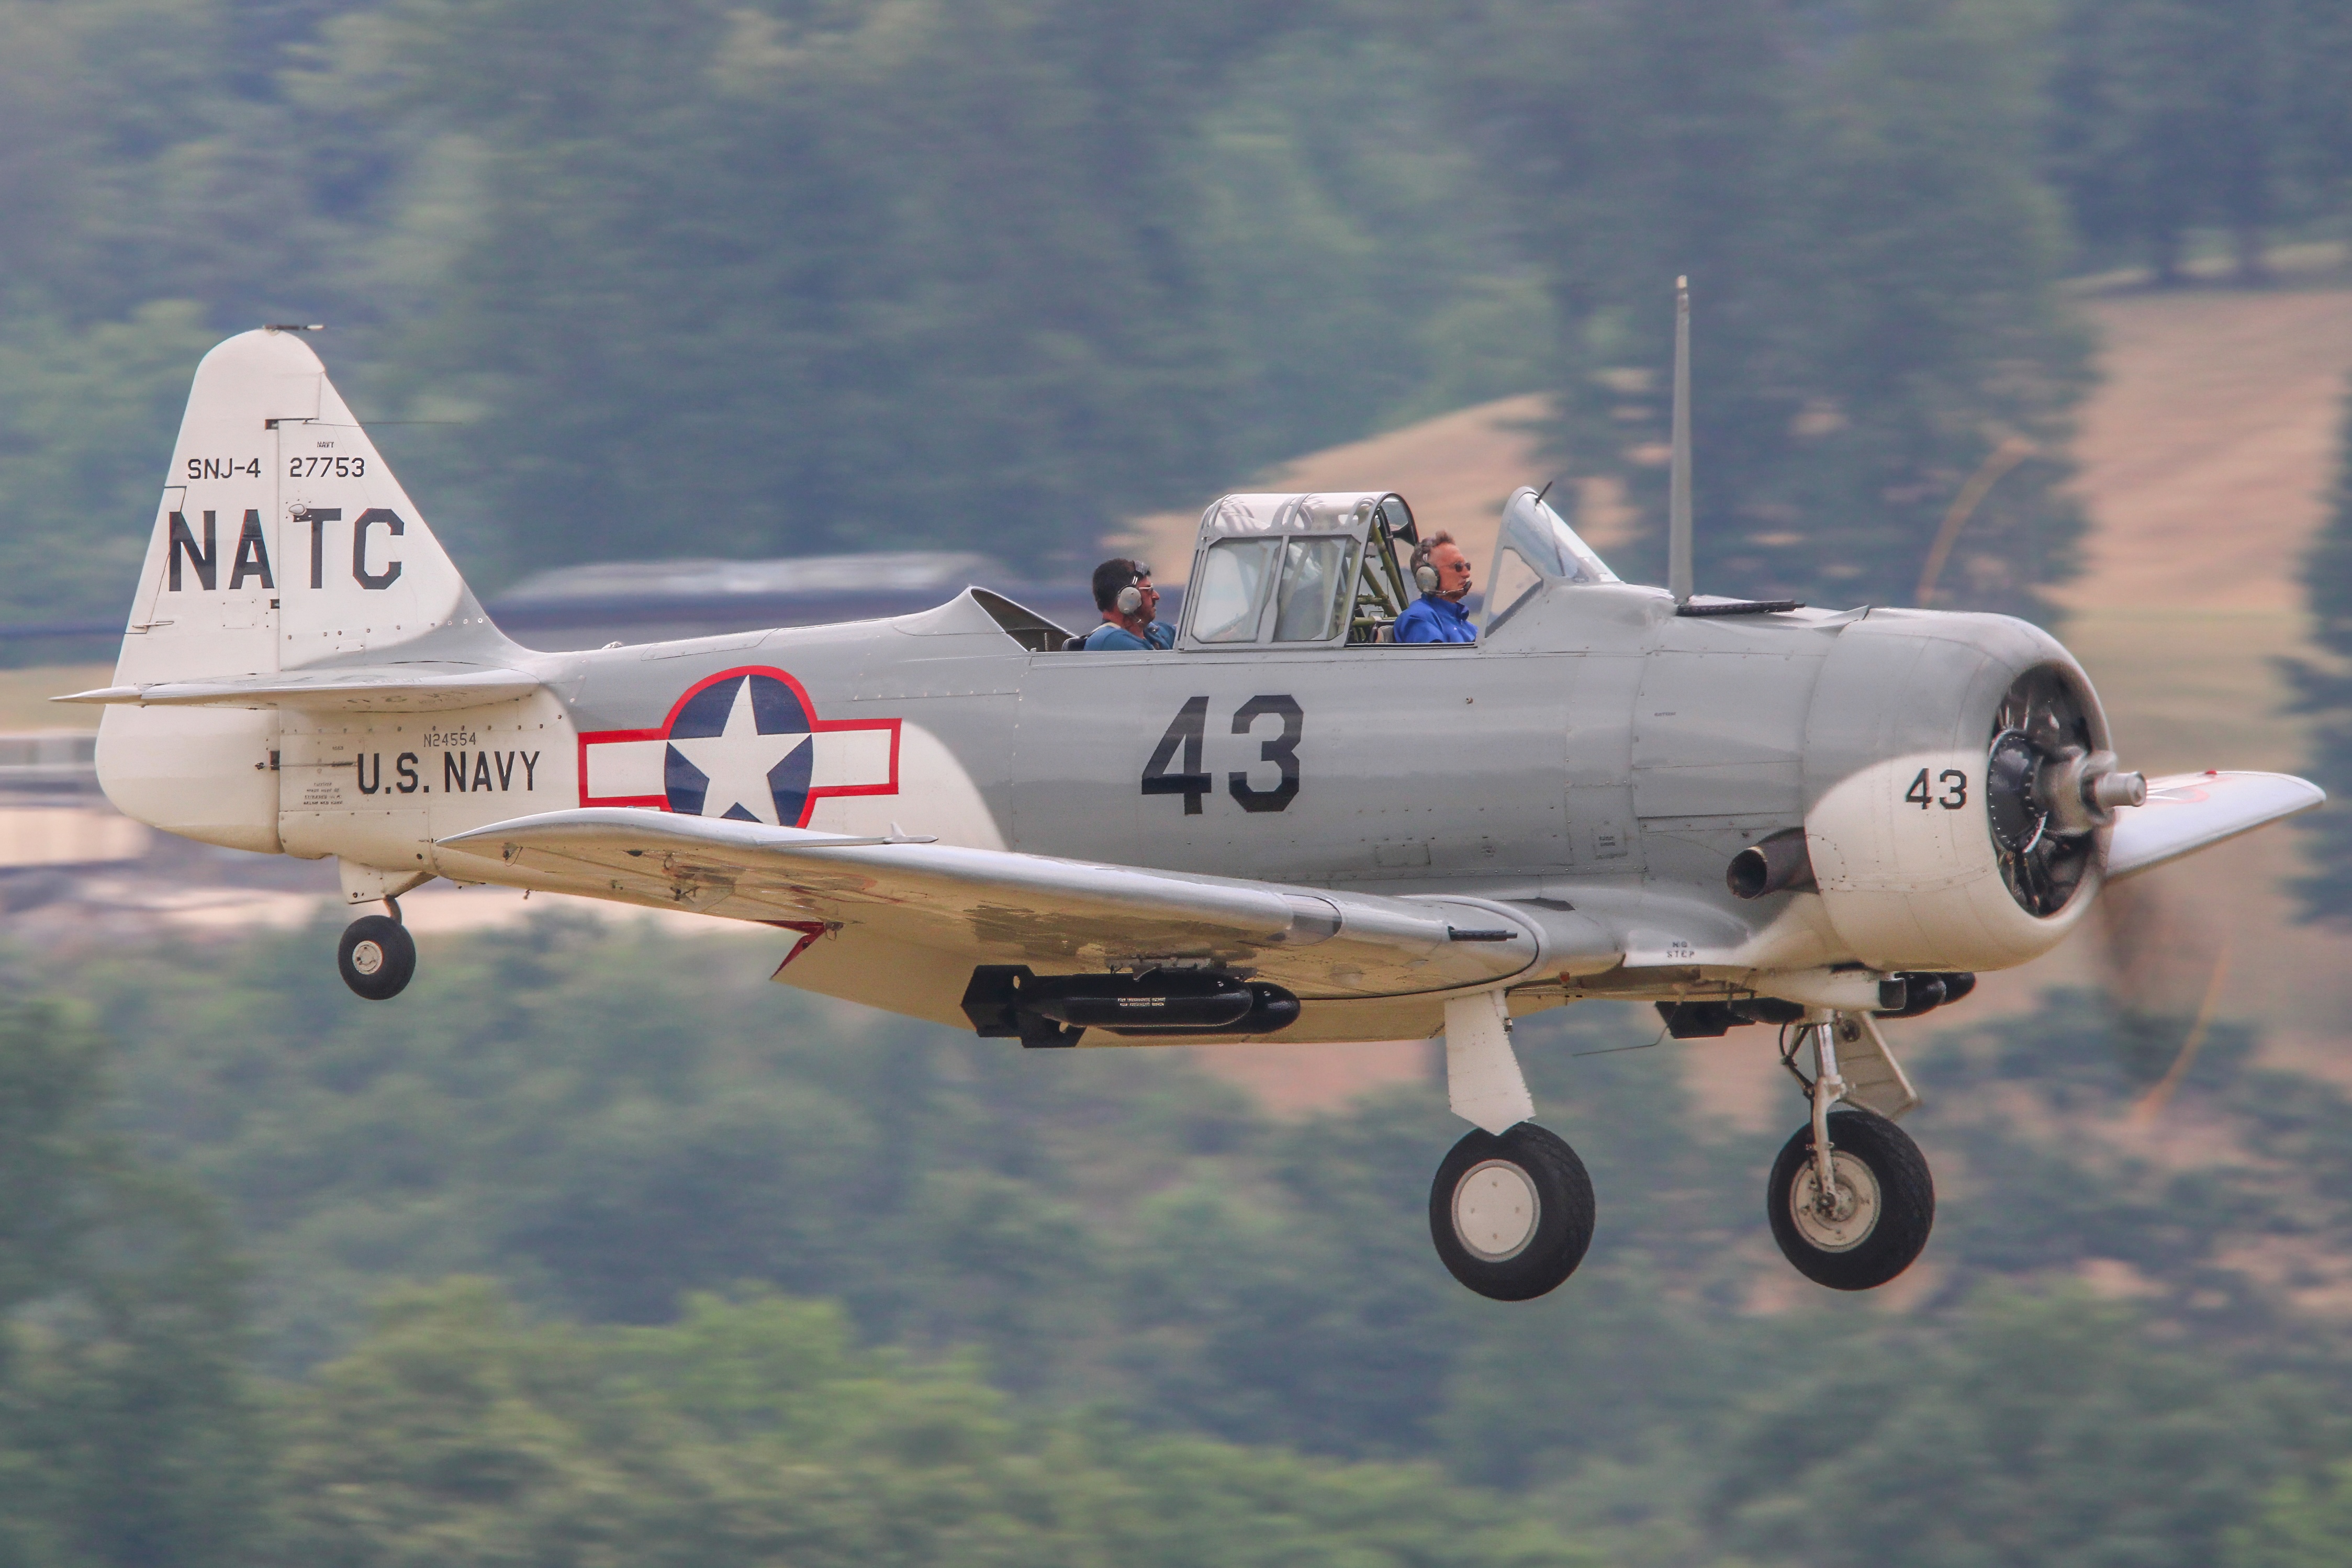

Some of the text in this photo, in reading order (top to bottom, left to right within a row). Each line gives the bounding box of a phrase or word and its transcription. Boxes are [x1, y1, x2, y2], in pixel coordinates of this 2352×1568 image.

[187, 457, 365, 479] SNJ-4 27753
[423, 732, 476, 747] N24554
[1141, 695, 1304, 814] 43
[357, 751, 540, 794] U.S. NAVY
[1905, 768, 1967, 810] 43
